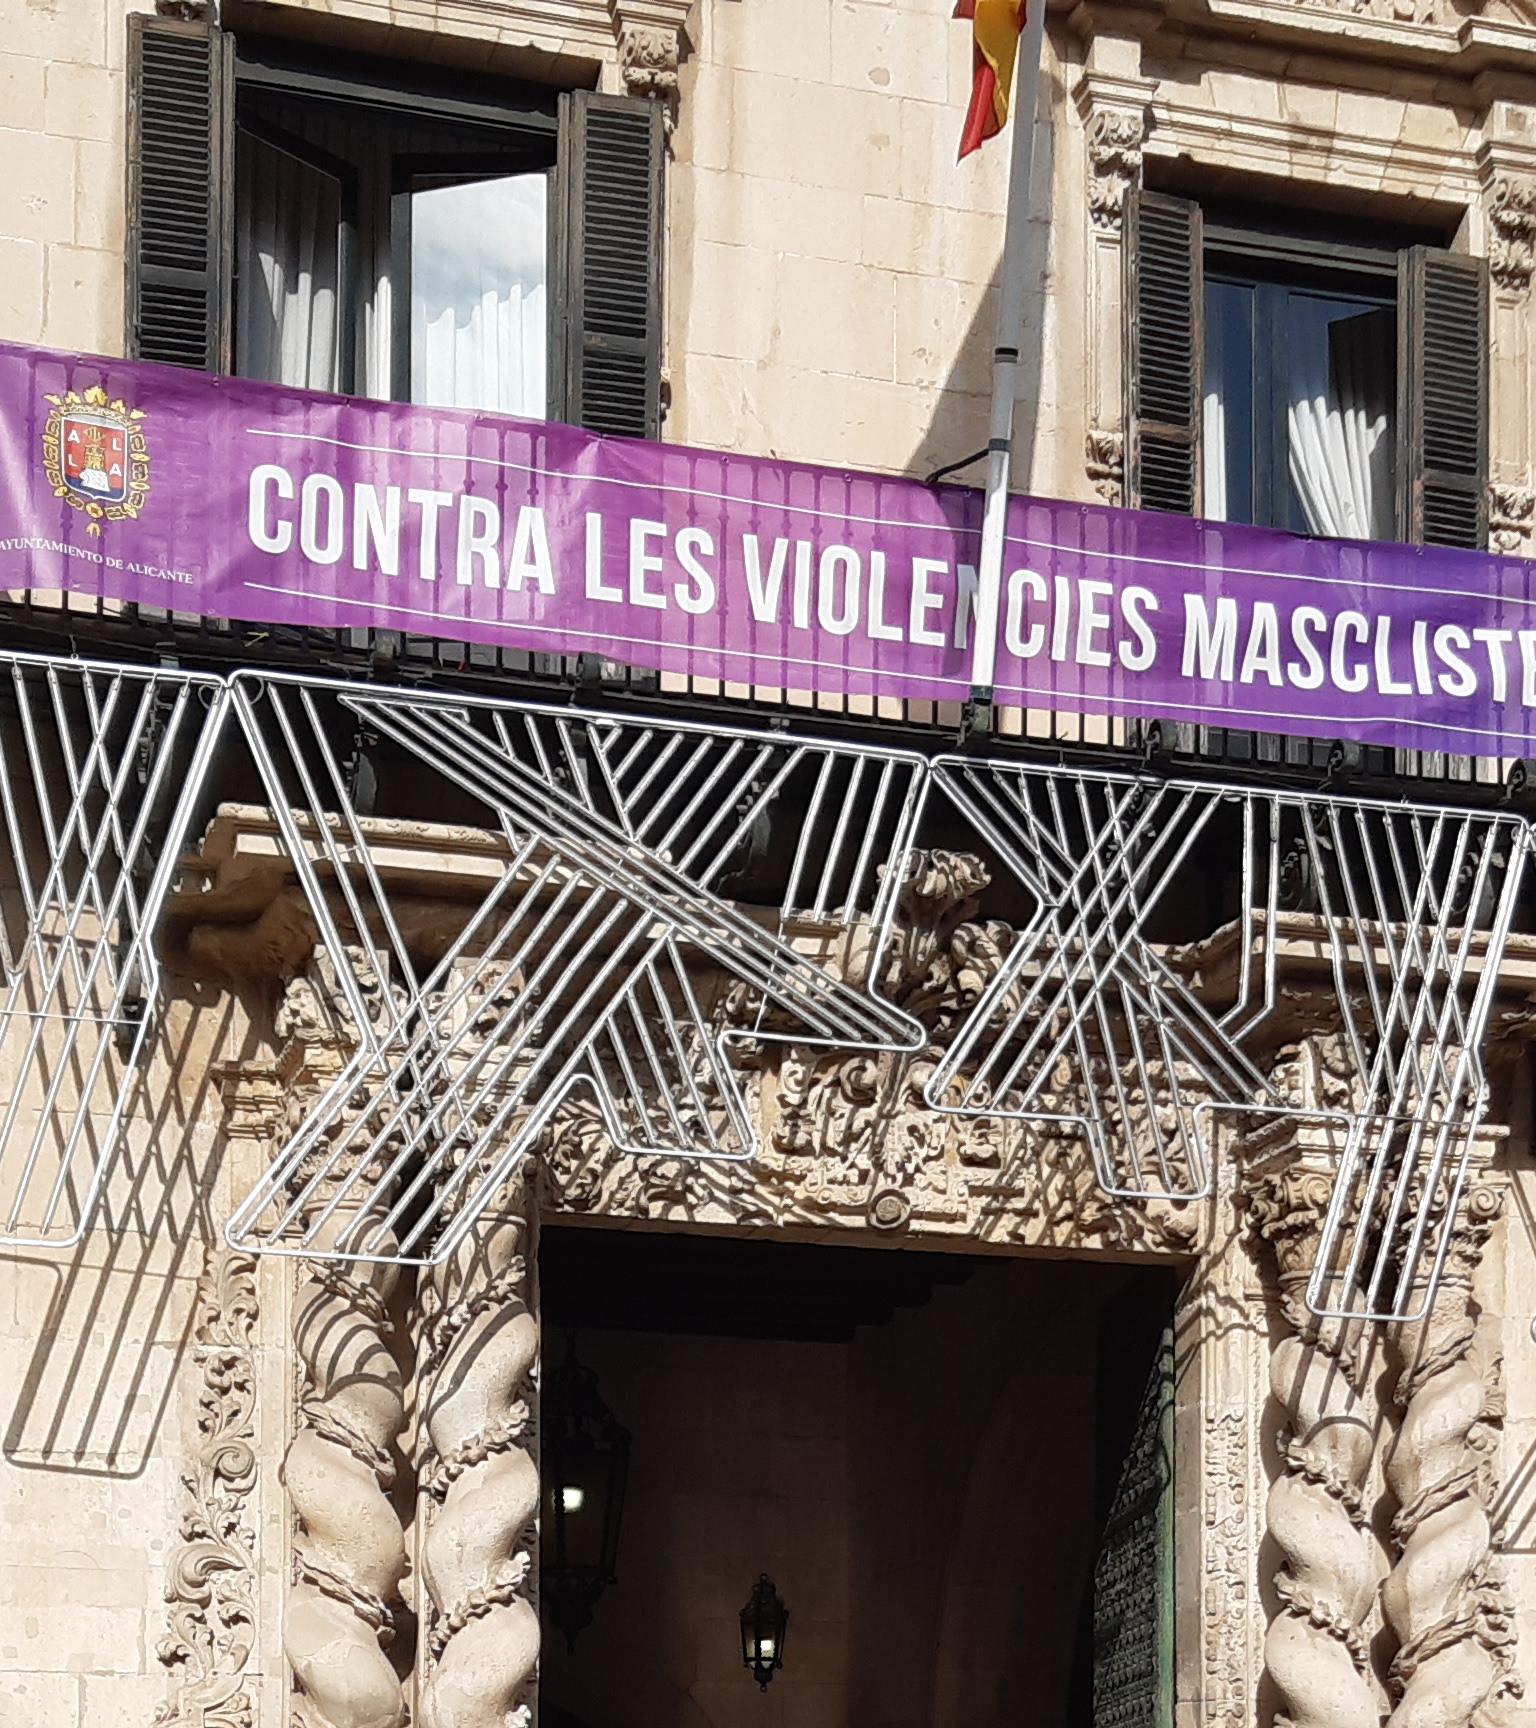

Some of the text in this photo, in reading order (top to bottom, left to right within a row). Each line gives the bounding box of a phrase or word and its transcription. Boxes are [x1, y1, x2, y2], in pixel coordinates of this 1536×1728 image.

[105, 556, 124, 570] DE
[127, 559, 194, 584] ALICANTE
[249, 464, 555, 594] CONTRA
[585, 512, 715, 614] LES
